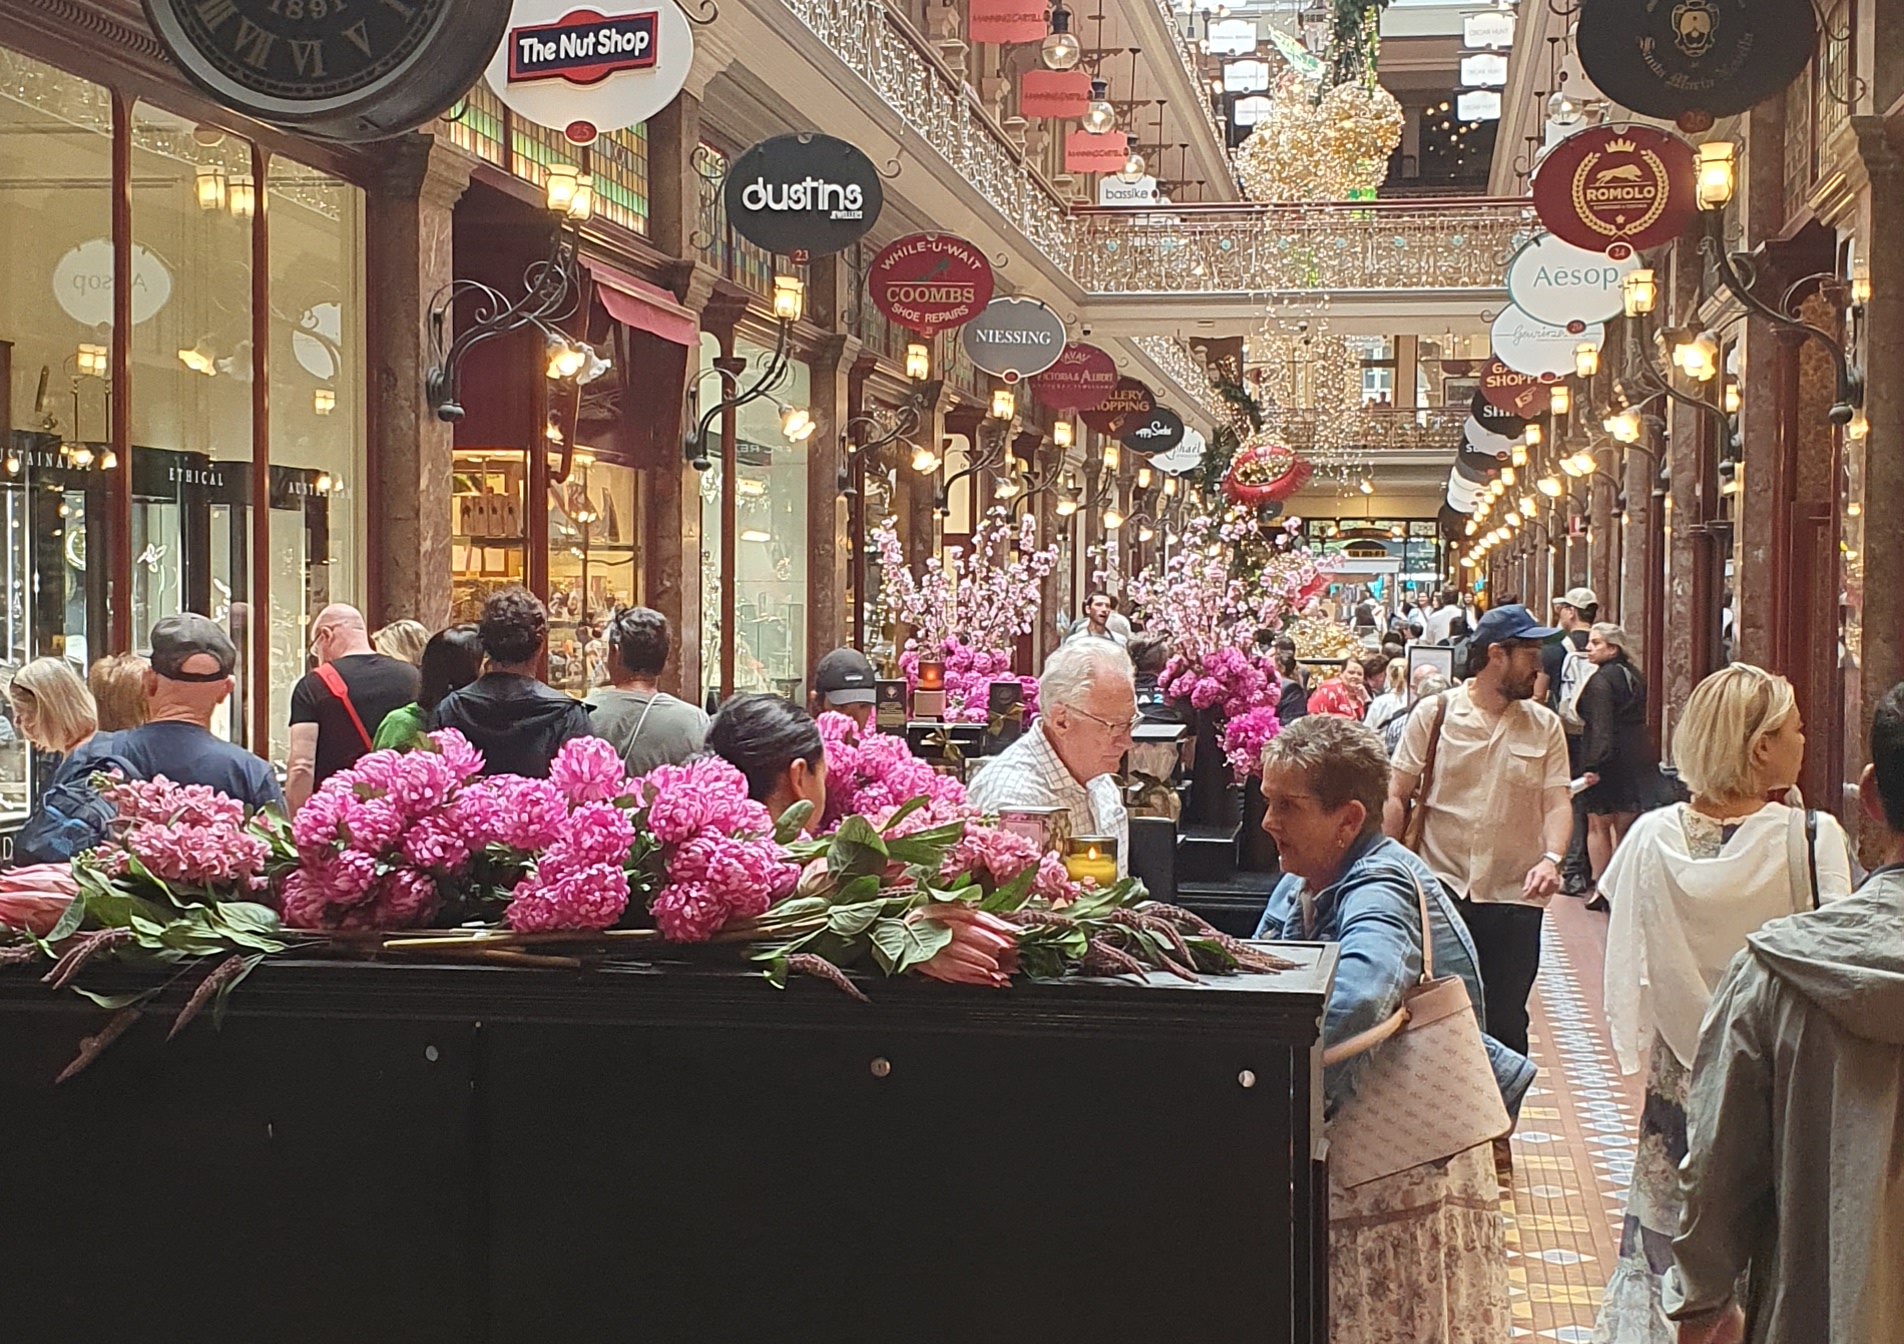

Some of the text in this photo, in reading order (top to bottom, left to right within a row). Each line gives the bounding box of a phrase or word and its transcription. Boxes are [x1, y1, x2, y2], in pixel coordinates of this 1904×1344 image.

[519, 28, 649, 64] The Nut Shop
[573, 125, 590, 139] 25
[742, 176, 863, 211] dustins
[1105, 188, 1149, 200] bassike
[1586, 186, 1656, 201] ROMOLO
[795, 250, 809, 262] 23
[881, 242, 982, 271] WHILE-U-WAIT
[886, 287, 975, 304] COOMBS
[891, 302, 969, 324] SHOE REPAIRS
[976, 329, 1052, 346] NIESSING
[1486, 374, 1565, 387] SHOPP
[1108, 390, 1145, 401] LLERY
[1090, 400, 1150, 412] OPPING
[169, 467, 224, 487] ETHICAL
